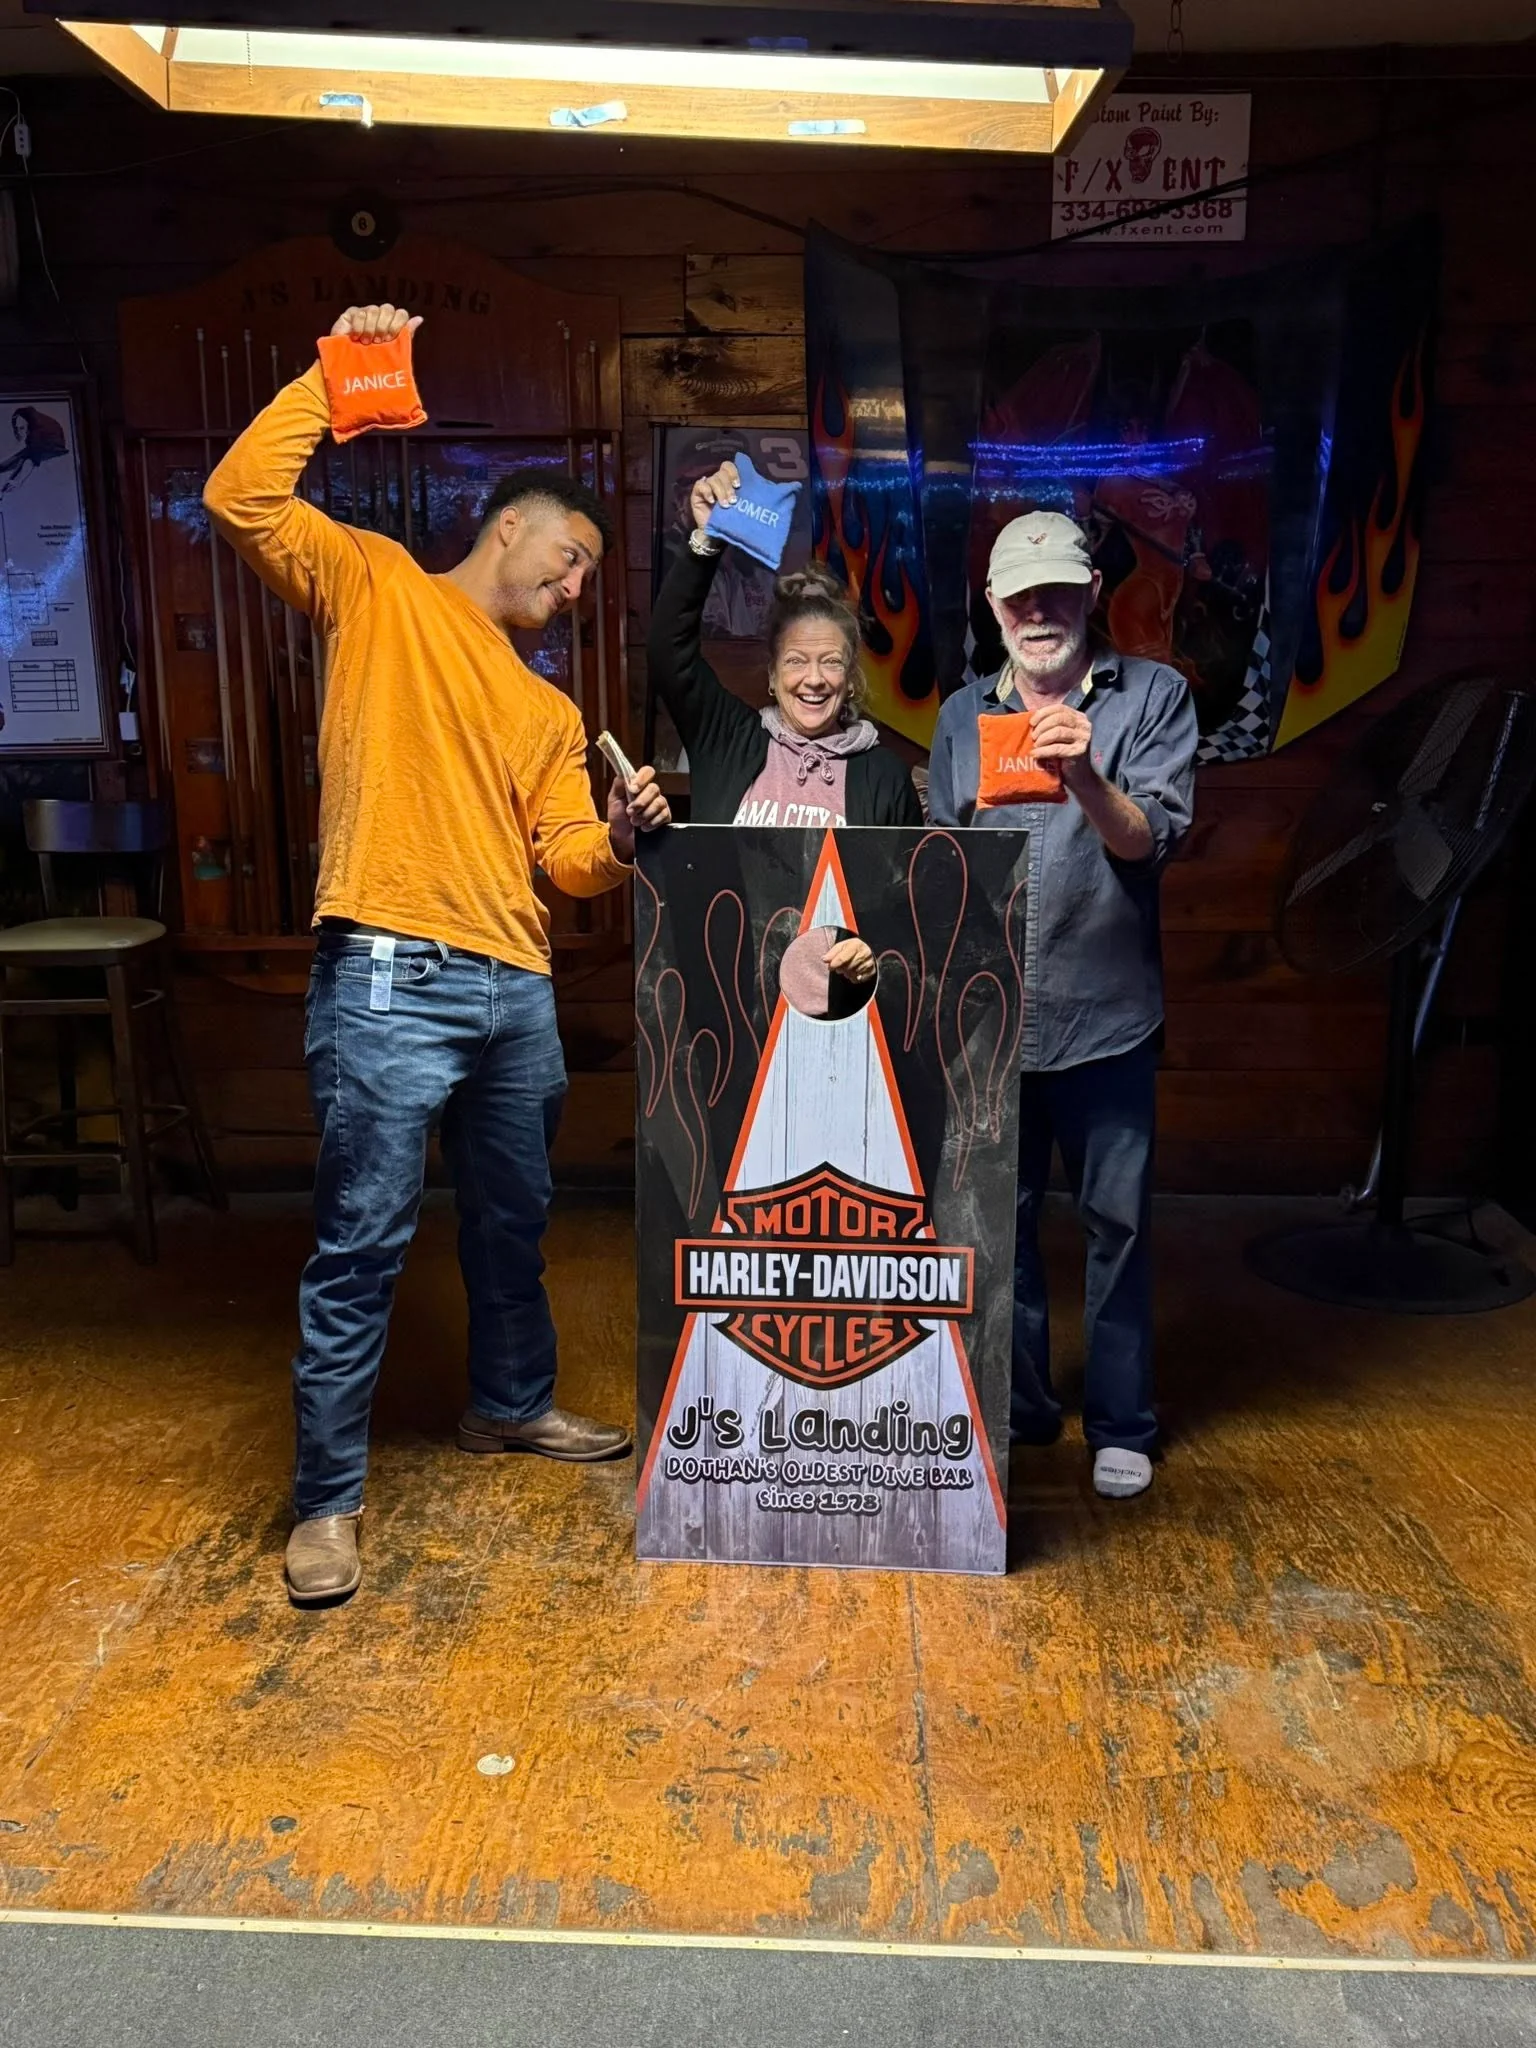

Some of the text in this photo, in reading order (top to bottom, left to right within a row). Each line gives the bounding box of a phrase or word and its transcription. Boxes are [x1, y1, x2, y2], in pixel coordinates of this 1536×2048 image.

[1138, 102, 1182, 123] Paint
[1190, 101, 1219, 127] By:
[1162, 156, 1226, 192] ENT
[312, 275, 492, 315] LANDING
[343, 370, 407, 395] JANICE
[759, 437, 809, 479] 3
[782, 803, 831, 827] CITY
[754, 1185, 897, 1239] MOTOR
[688, 1250, 961, 1302] HARLEY-DAVIDSON
[751, 1312, 894, 1372] CYCLES
[759, 1399, 973, 1460] Landing
[781, 1459, 867, 1487] OLDEST
[868, 1463, 926, 1490] DIVE
[928, 1466, 974, 1490] BAR
[816, 1491, 882, 1516] 1978
